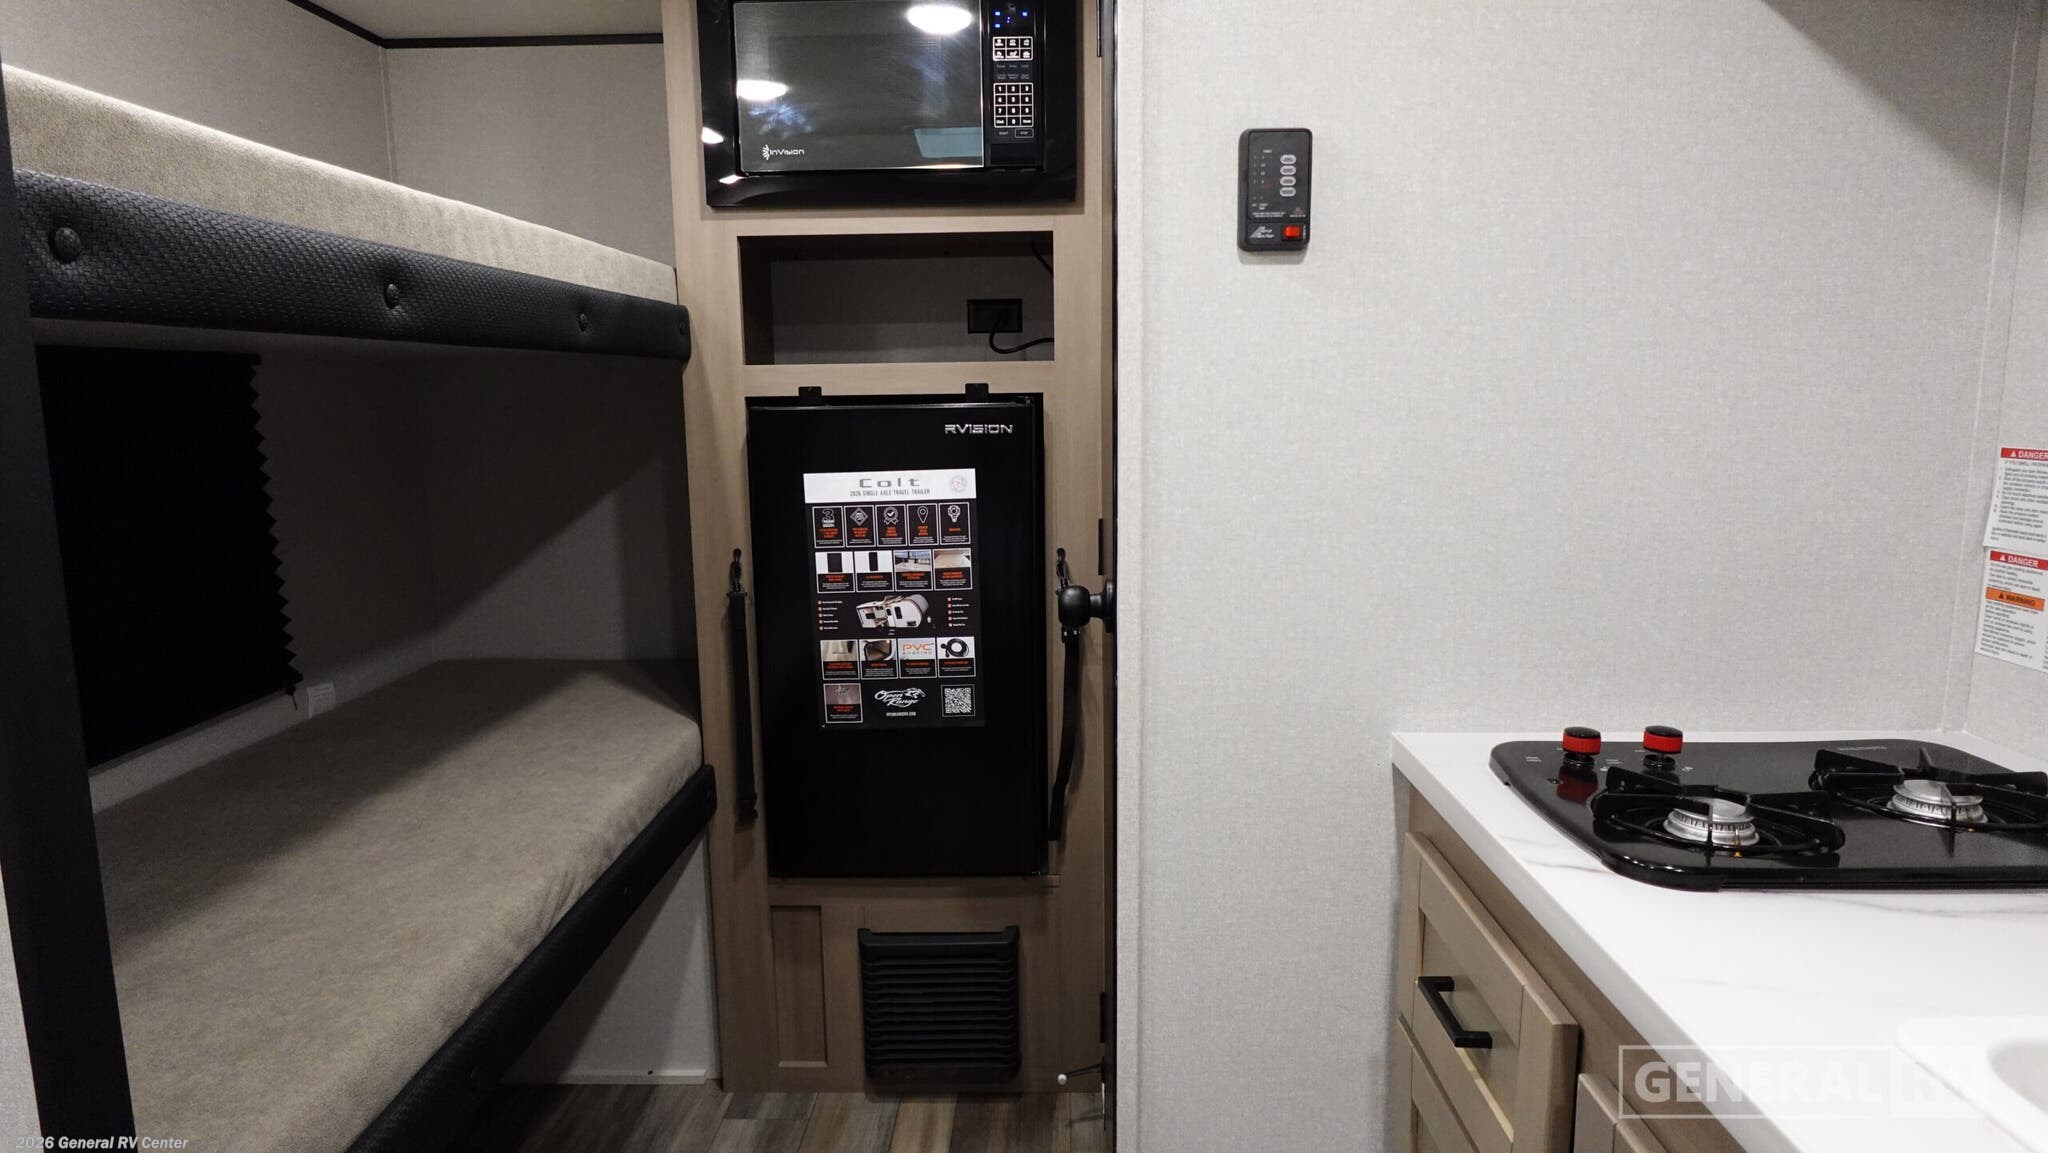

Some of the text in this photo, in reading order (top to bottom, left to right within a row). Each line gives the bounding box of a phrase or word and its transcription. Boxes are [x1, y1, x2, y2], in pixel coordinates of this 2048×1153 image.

[944, 424, 1013, 434] RVISION
[859, 477, 920, 488] Colt
[2008, 555, 2039, 568] DANGER
[903, 643, 931, 651] PVC
[874, 690, 903, 702] Open
